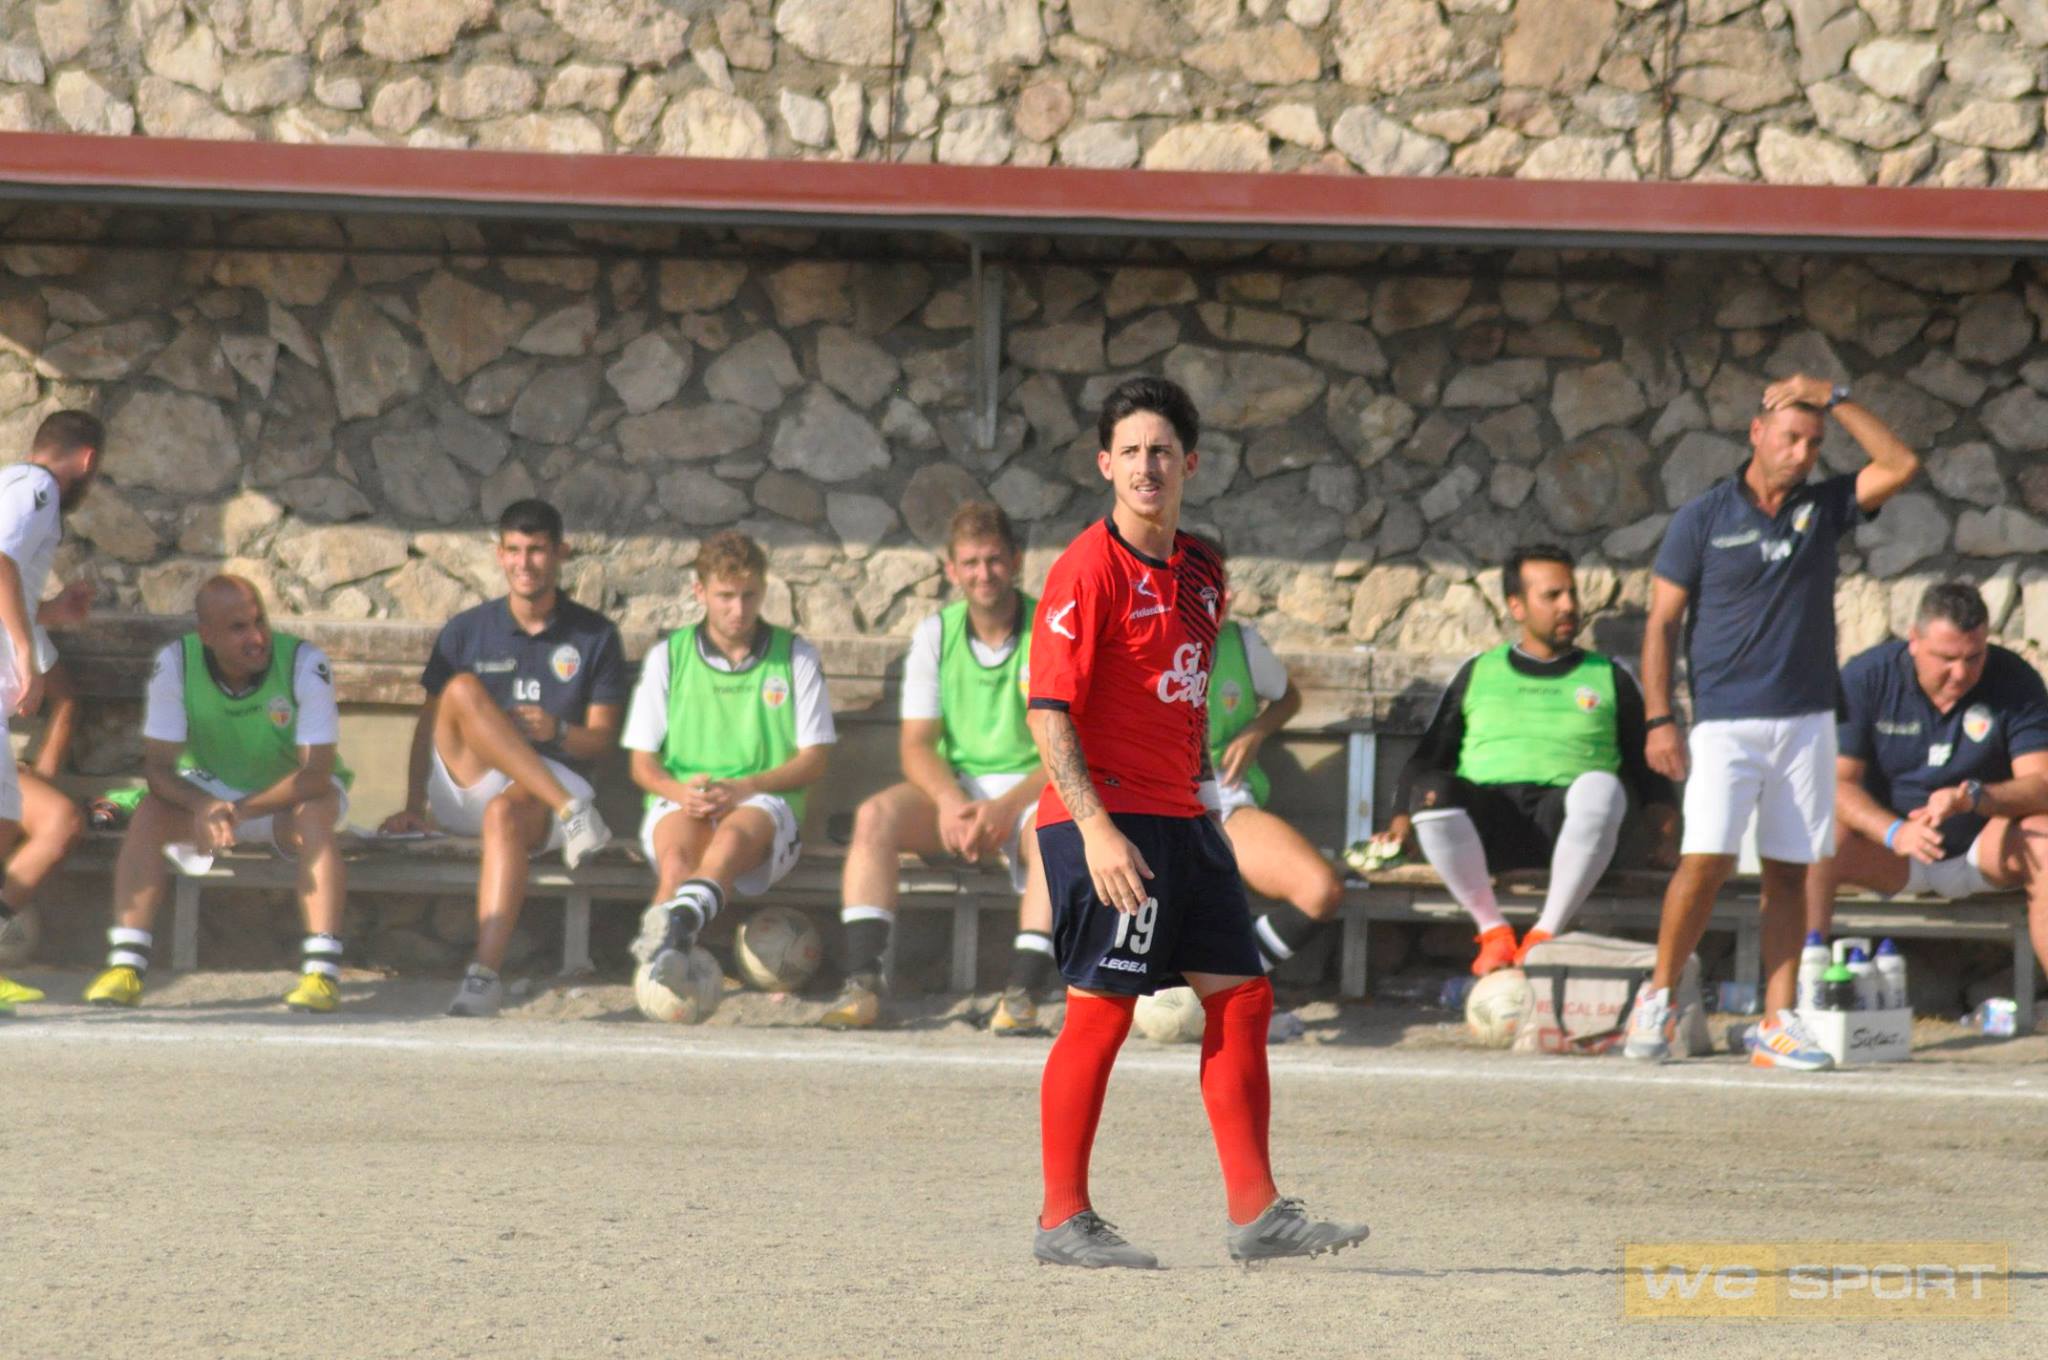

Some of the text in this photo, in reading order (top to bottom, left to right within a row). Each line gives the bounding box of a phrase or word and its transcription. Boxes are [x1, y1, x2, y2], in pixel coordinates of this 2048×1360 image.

[1173, 642, 1203, 676] Gi
[515, 678, 541, 701] LG
[1114, 896, 1159, 955] 19
[1099, 957, 1148, 974] LEGEA
